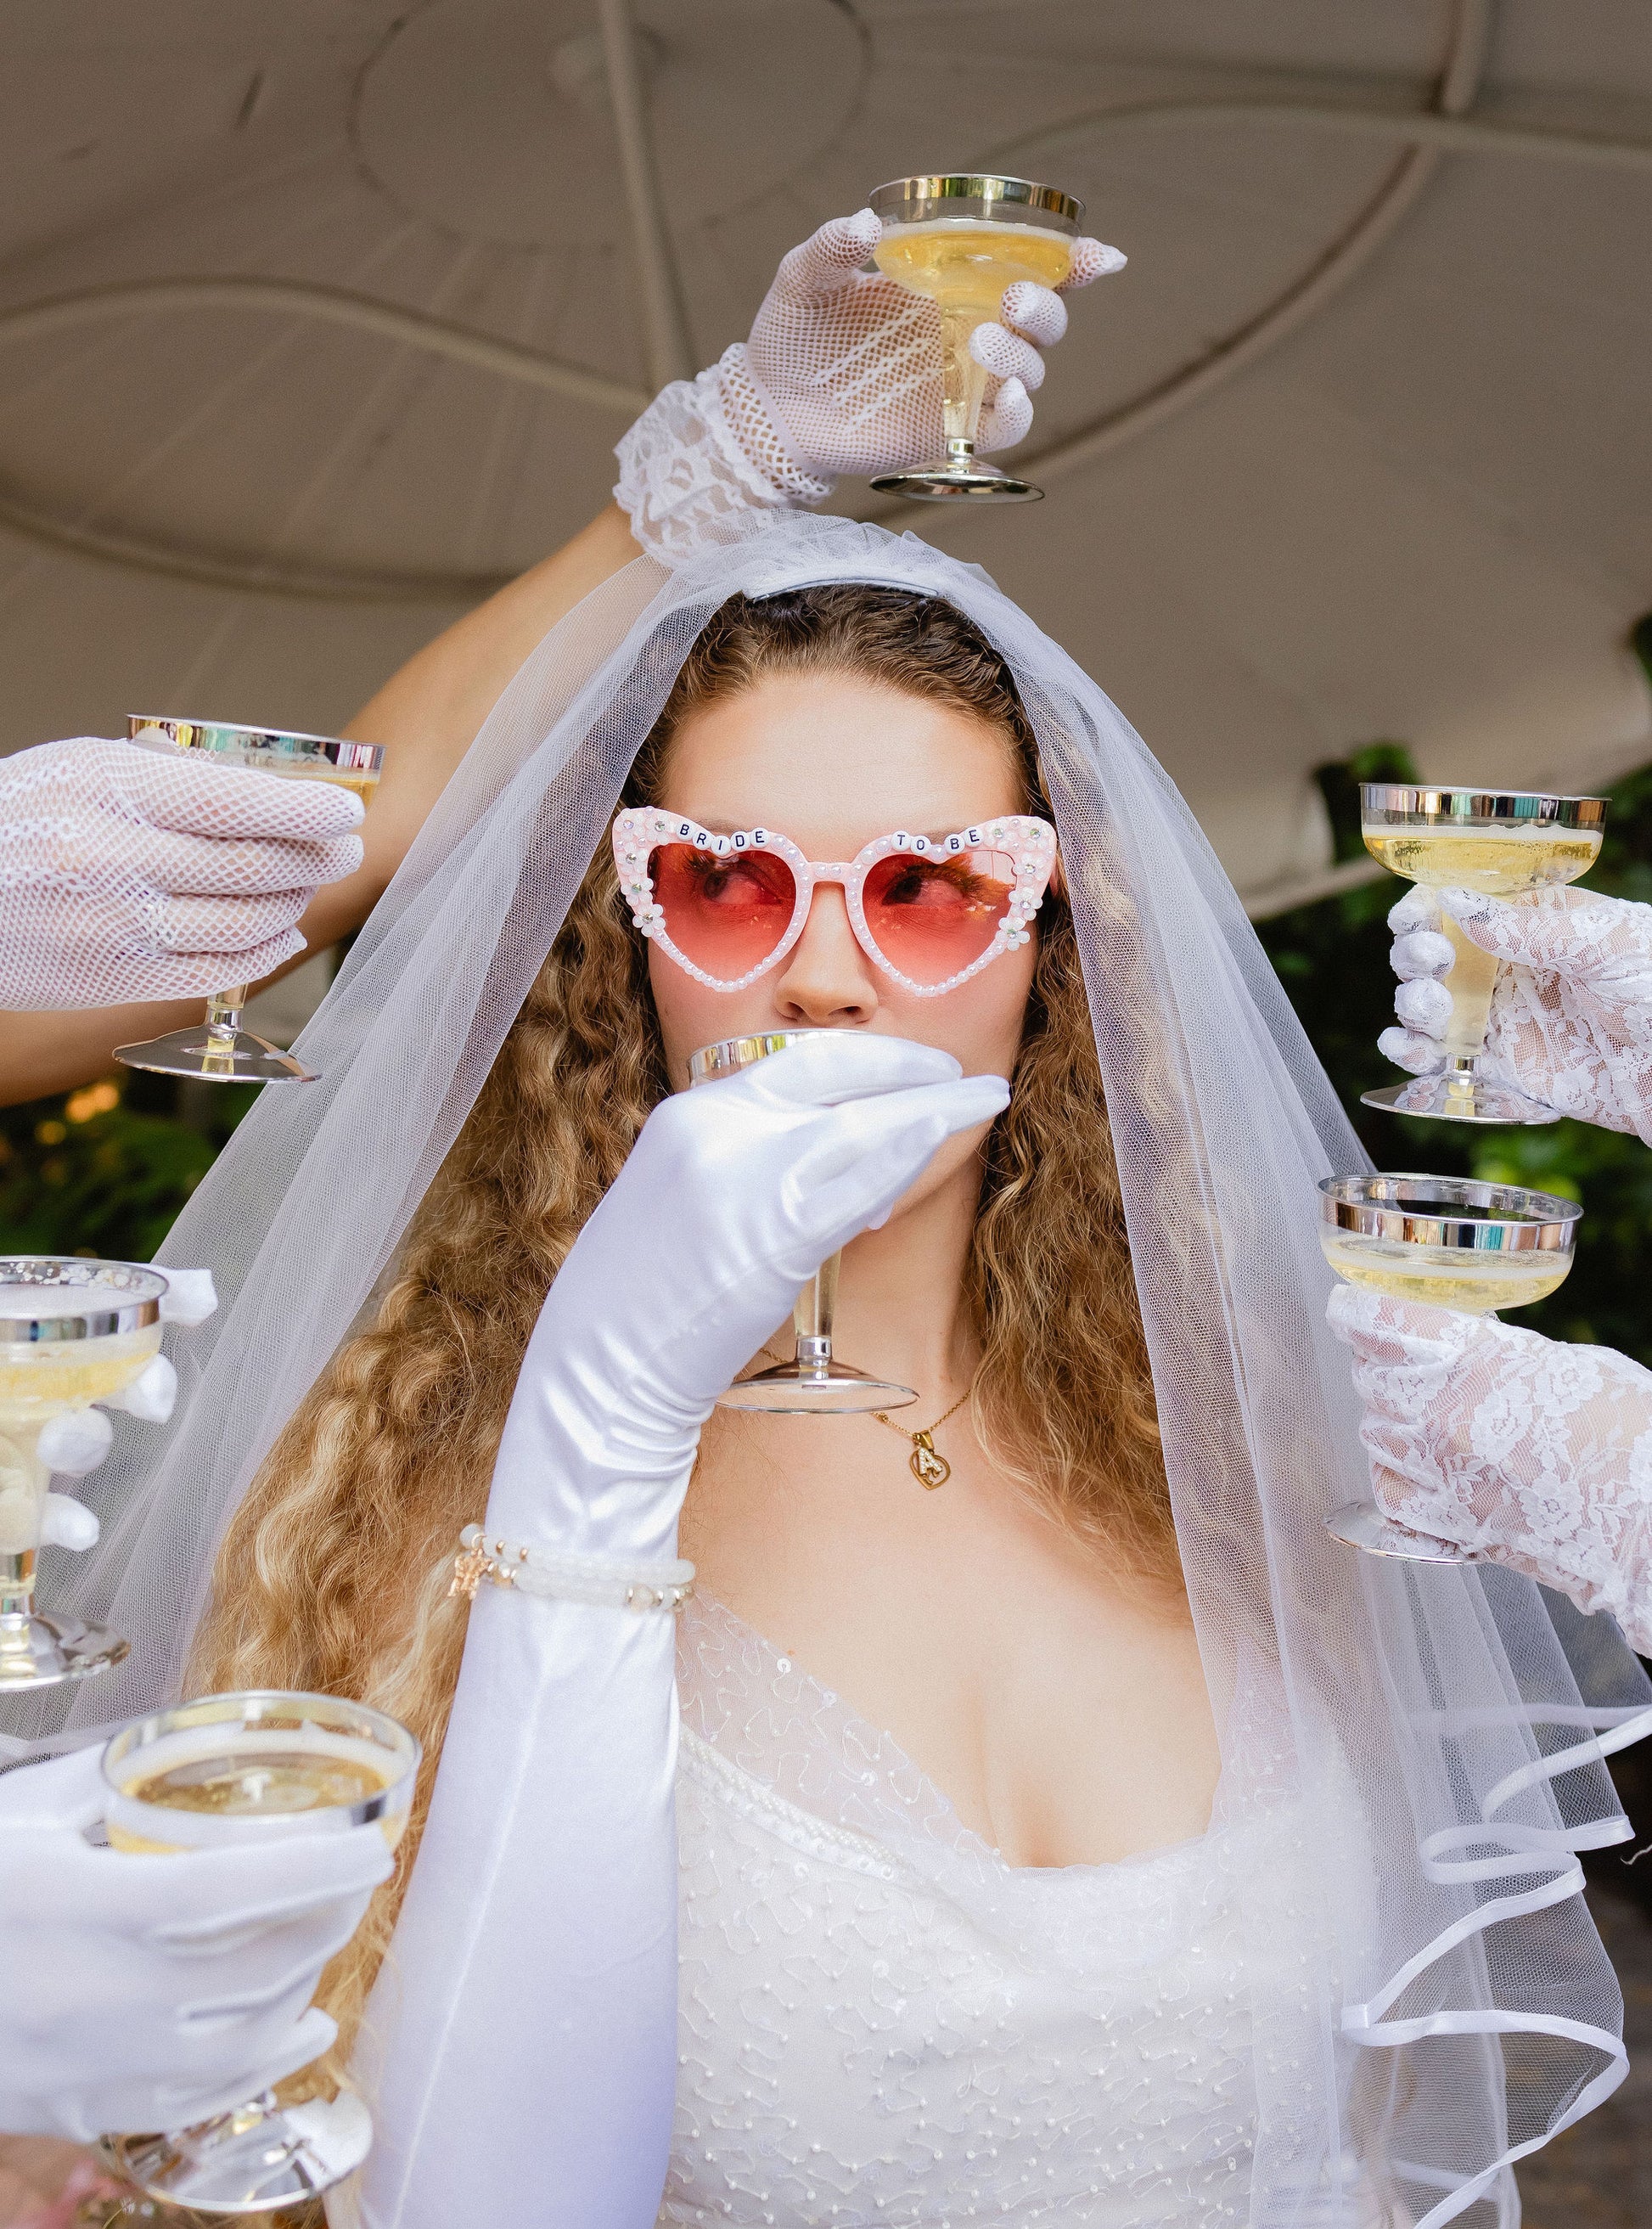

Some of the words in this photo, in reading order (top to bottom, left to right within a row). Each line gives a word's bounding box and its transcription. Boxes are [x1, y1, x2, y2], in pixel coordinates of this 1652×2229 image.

[679, 824, 765, 851] BRIDE
[896, 834, 925, 851] TO
[950, 829, 980, 850] BE
[918, 1446, 942, 1475] A
